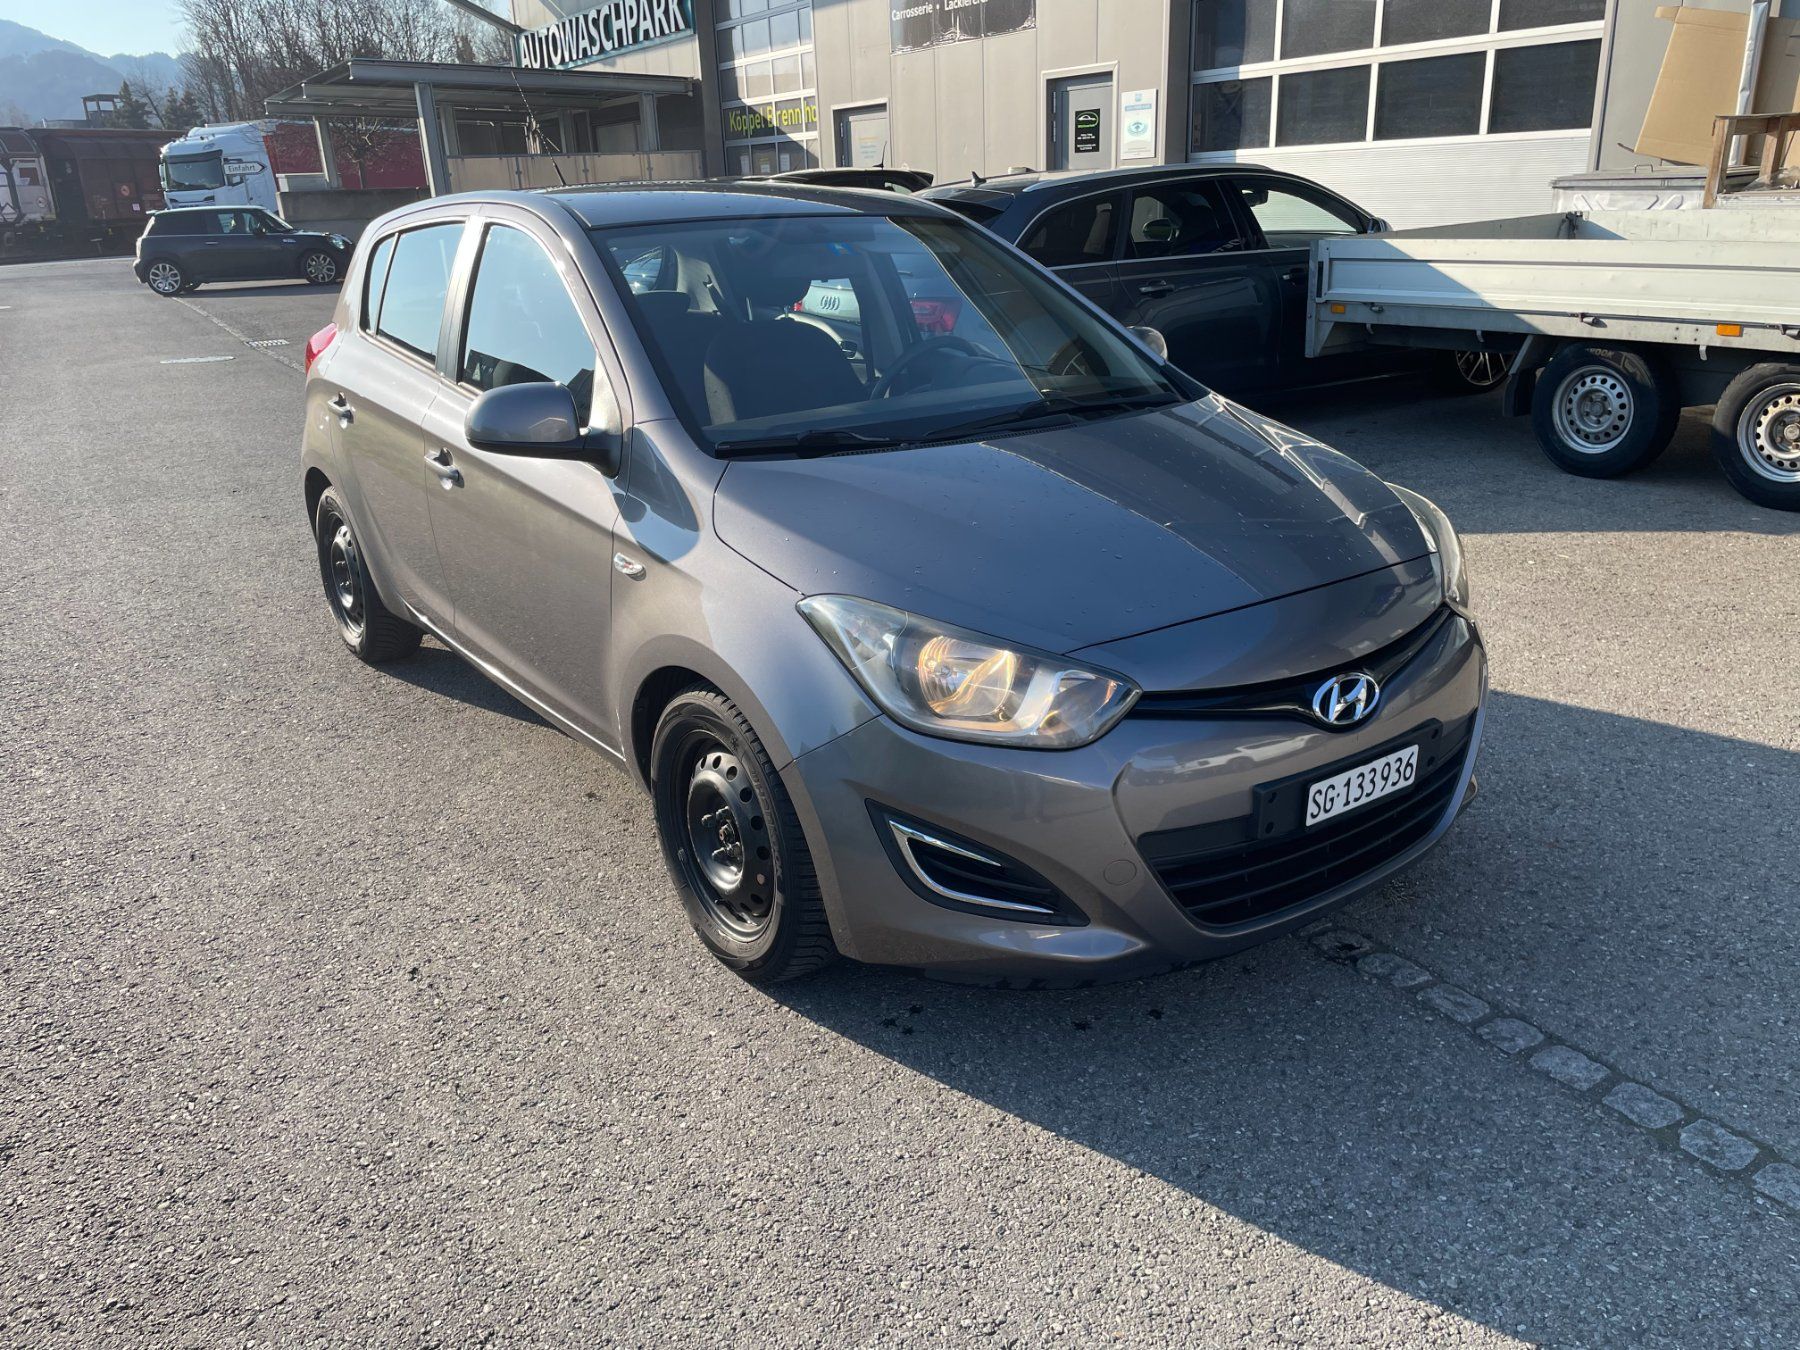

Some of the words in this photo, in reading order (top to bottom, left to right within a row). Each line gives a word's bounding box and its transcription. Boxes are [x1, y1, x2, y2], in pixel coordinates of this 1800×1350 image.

[891, 4, 933, 21] Carrosserie
[944, 0, 988, 11] Lackiere
[521, 0, 686, 68] AUTOWASCHPARK
[729, 105, 765, 136] Köppel
[228, 164, 256, 173] Einfahrt
